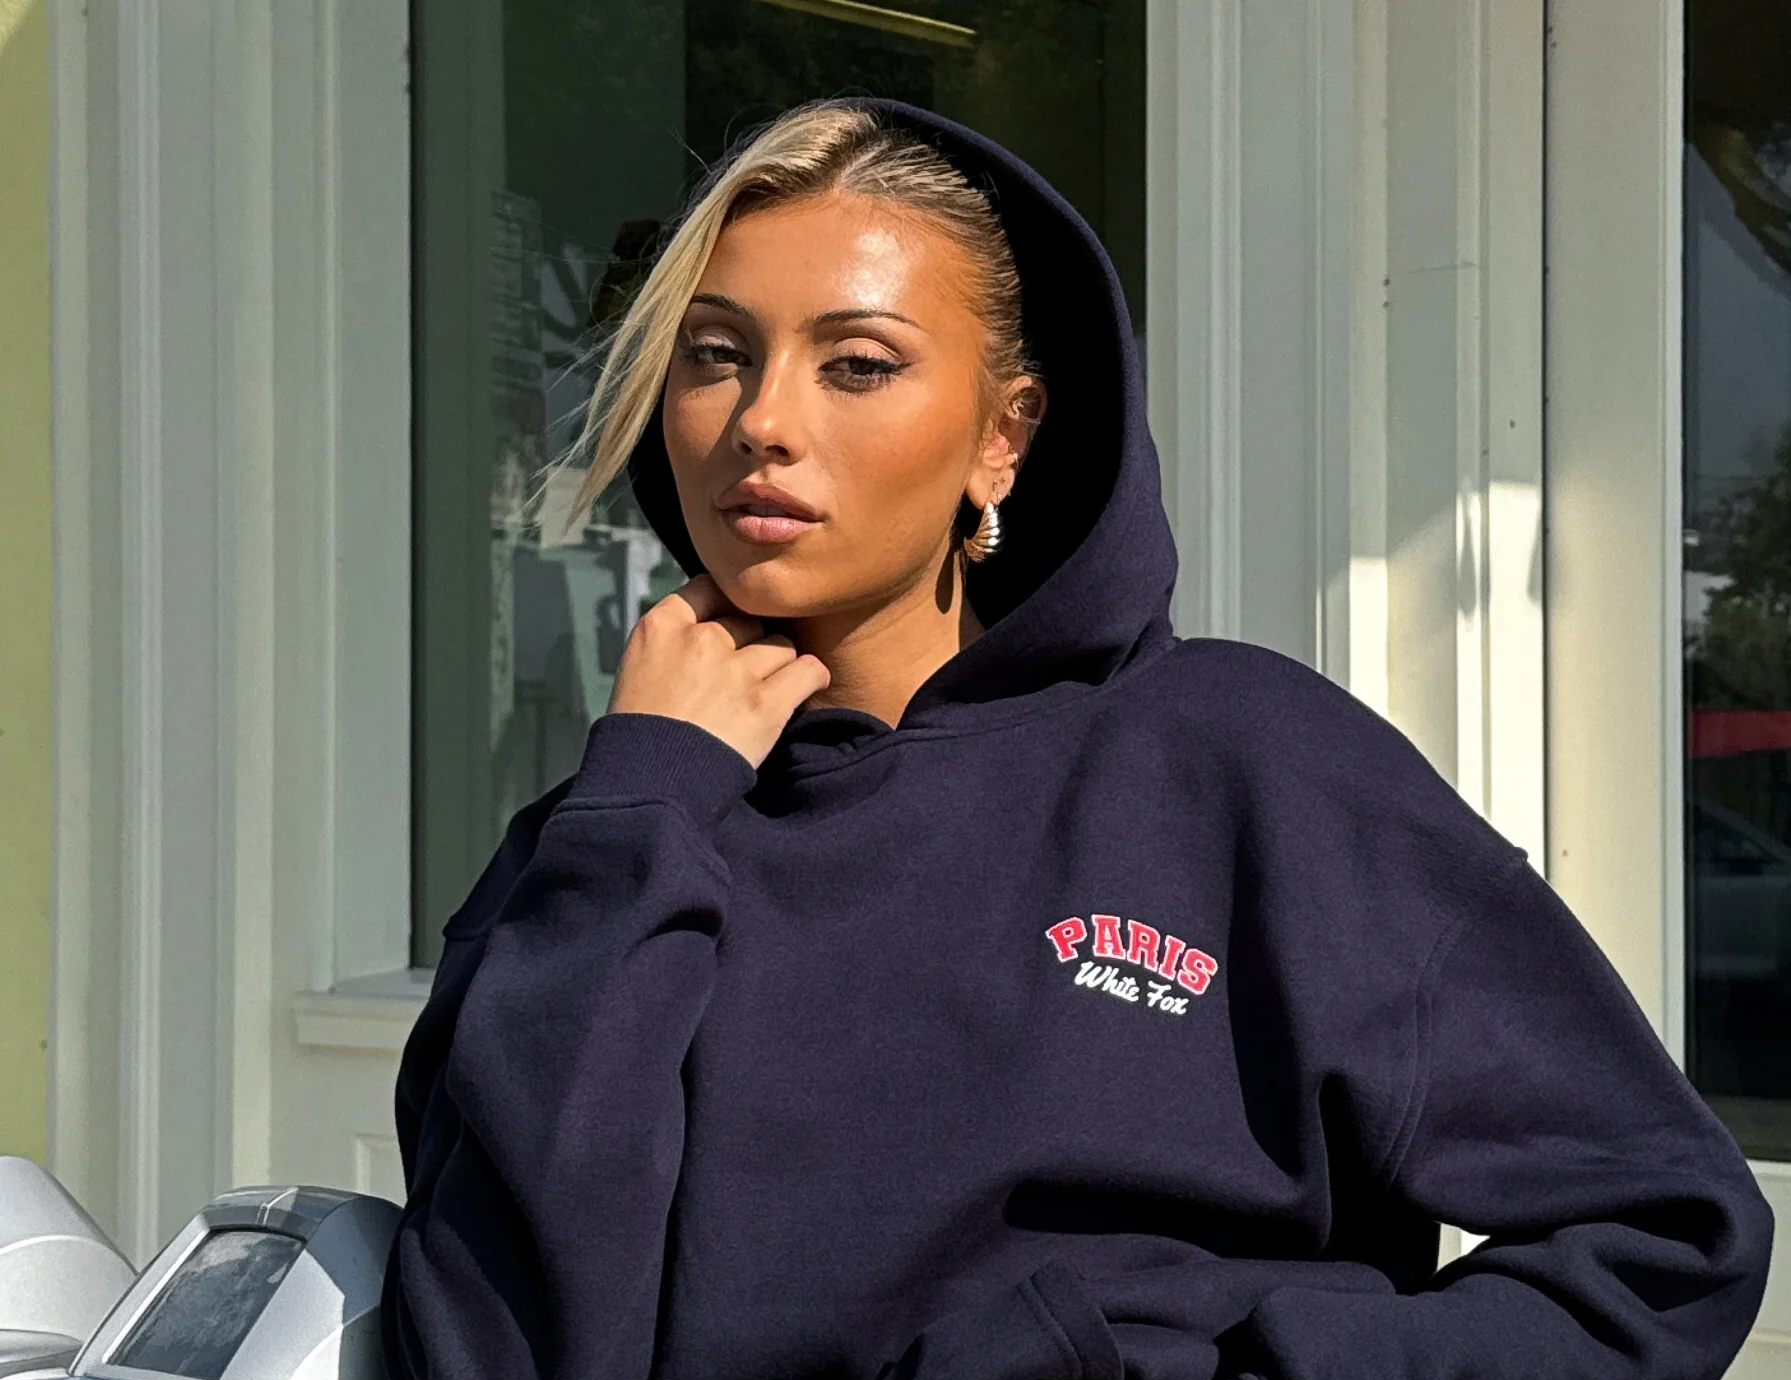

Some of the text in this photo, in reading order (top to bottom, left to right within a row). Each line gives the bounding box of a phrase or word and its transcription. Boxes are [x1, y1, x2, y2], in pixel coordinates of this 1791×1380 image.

[1045, 913, 1219, 995] PARIS
[1074, 961, 1190, 1015] White Fox
